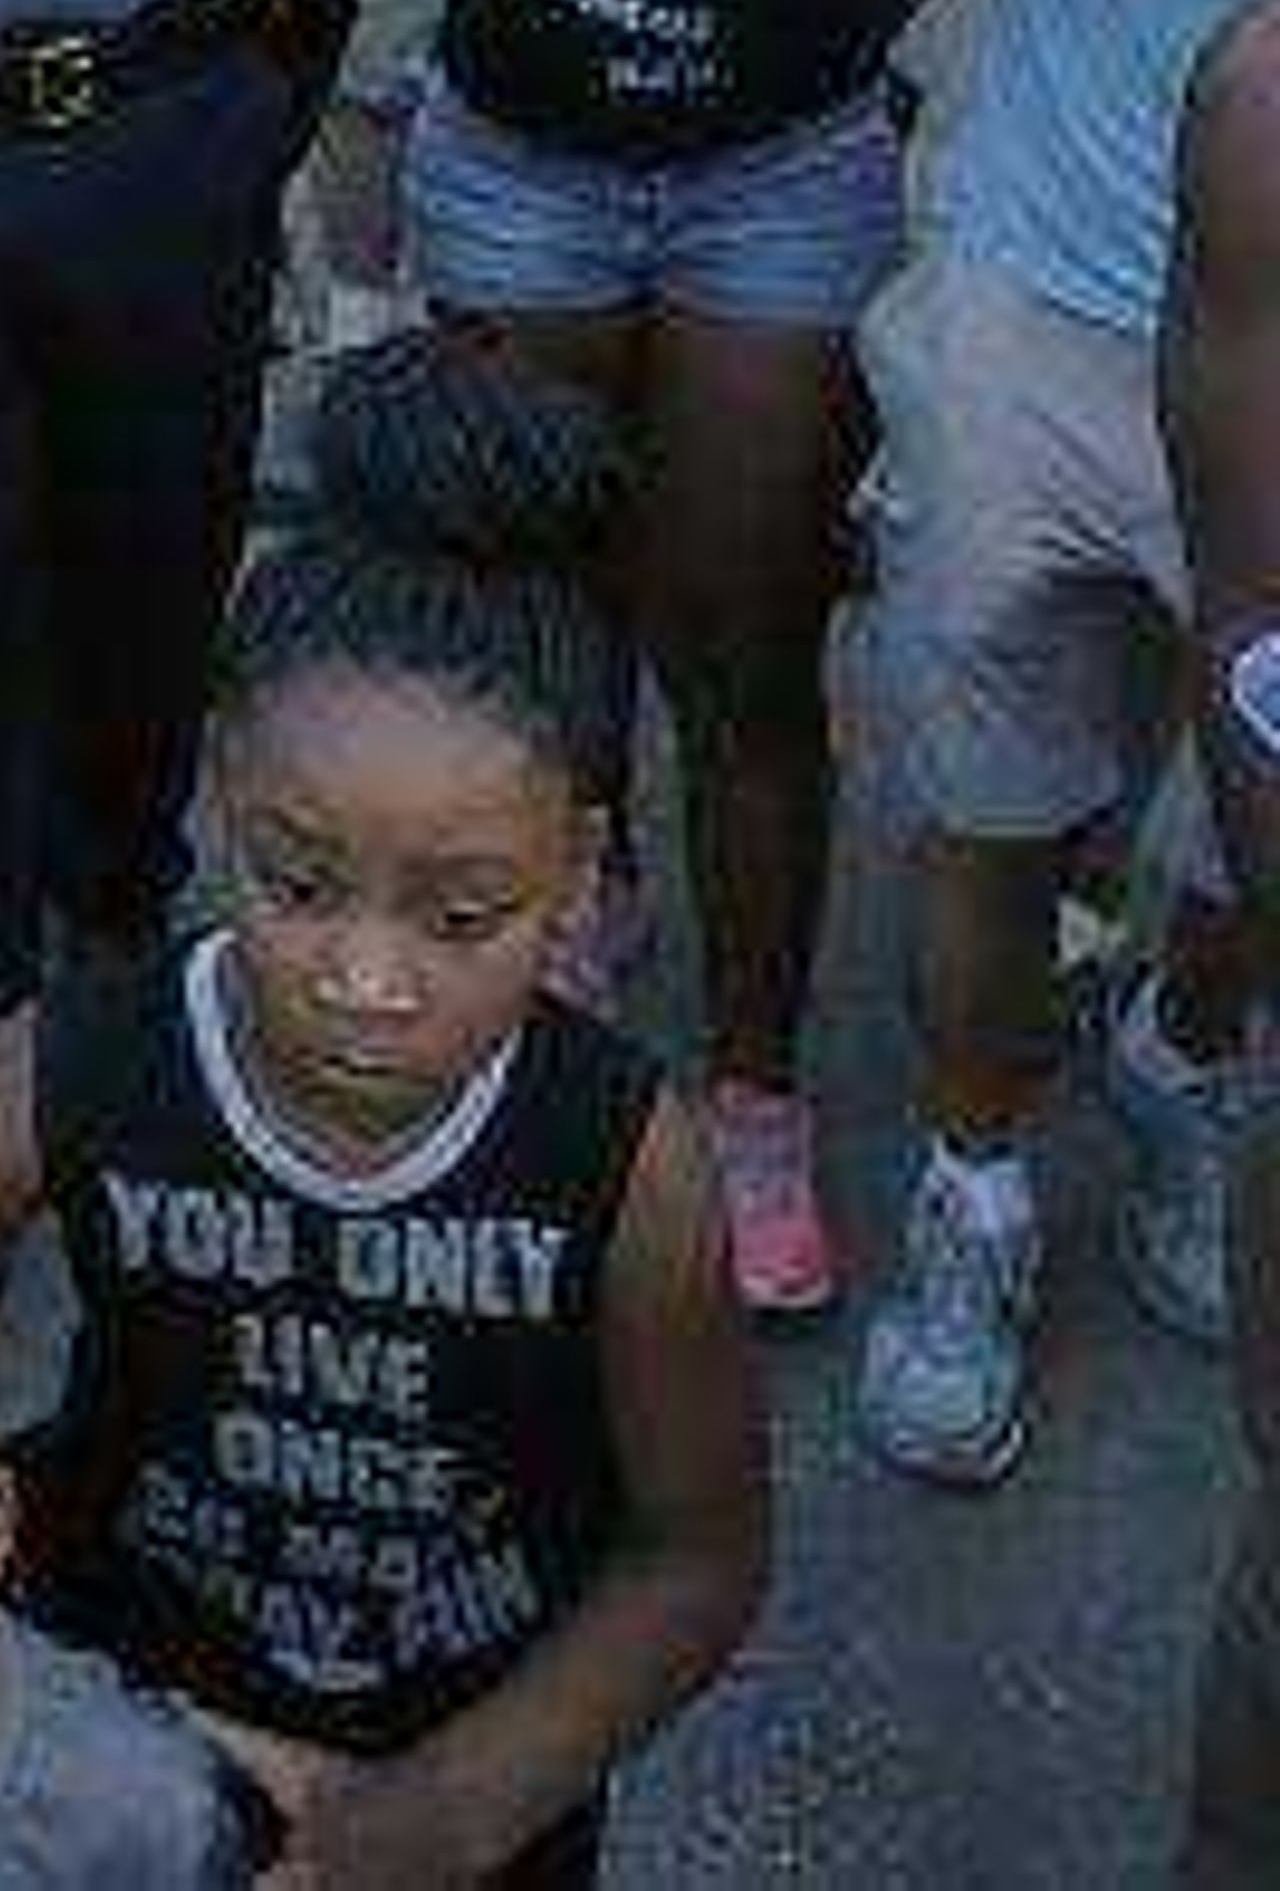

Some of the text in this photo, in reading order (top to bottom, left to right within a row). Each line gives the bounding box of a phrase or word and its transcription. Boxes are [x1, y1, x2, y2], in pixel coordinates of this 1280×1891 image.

[103, 1174, 572, 1317] YOU ONLY
[234, 1315, 428, 1414] LIVE
[214, 1417, 458, 1515] ONCE
